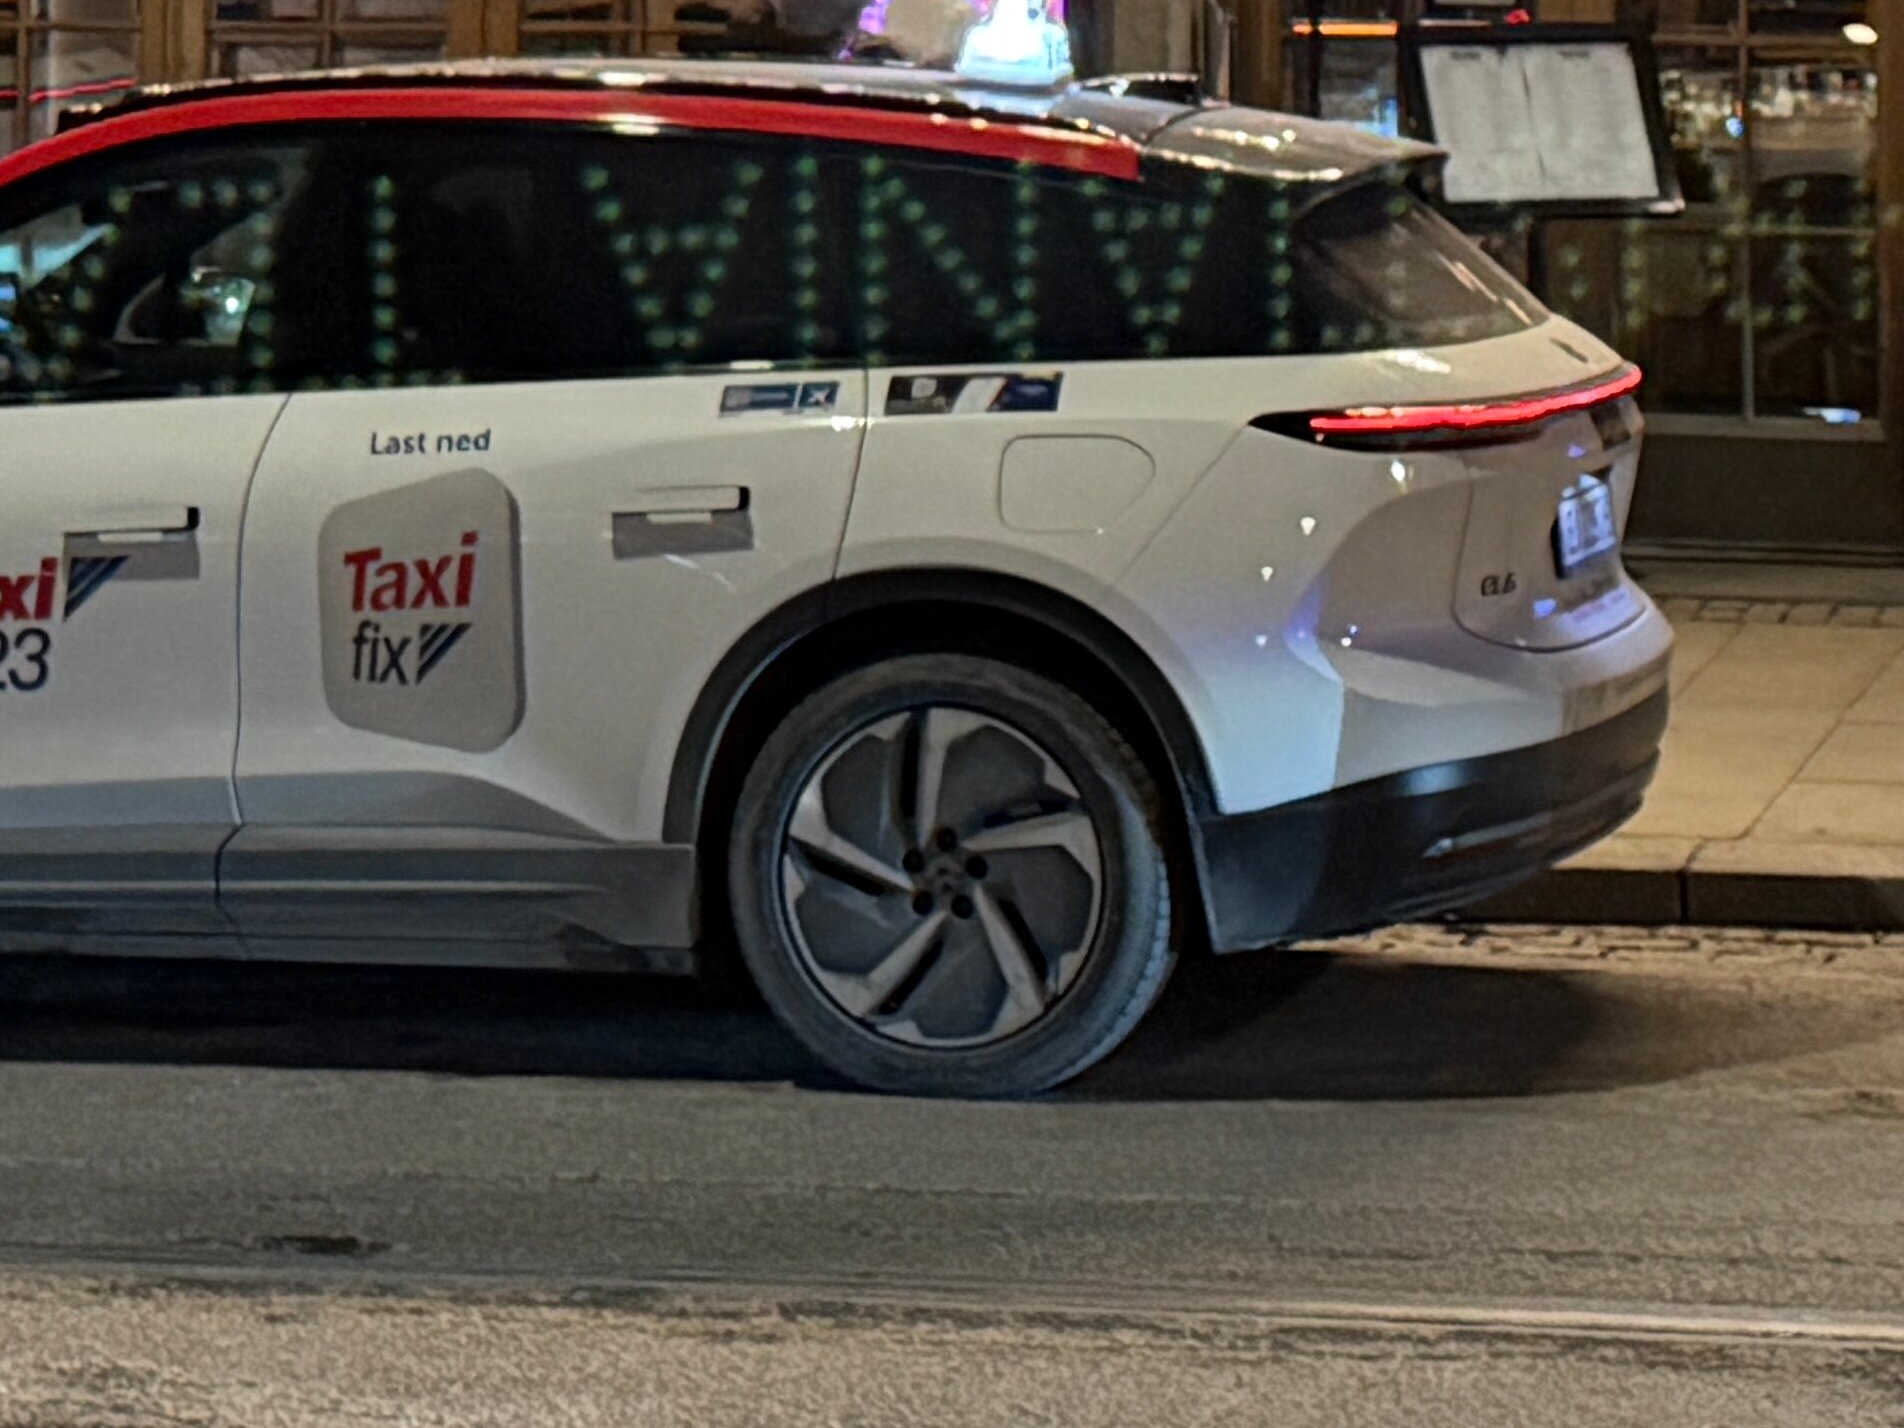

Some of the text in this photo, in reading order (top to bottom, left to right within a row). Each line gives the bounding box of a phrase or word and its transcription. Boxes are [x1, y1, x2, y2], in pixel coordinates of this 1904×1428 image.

[368, 428, 492, 457] Last ned
[343, 531, 480, 612] Taxi
[351, 622, 410, 687] fix
